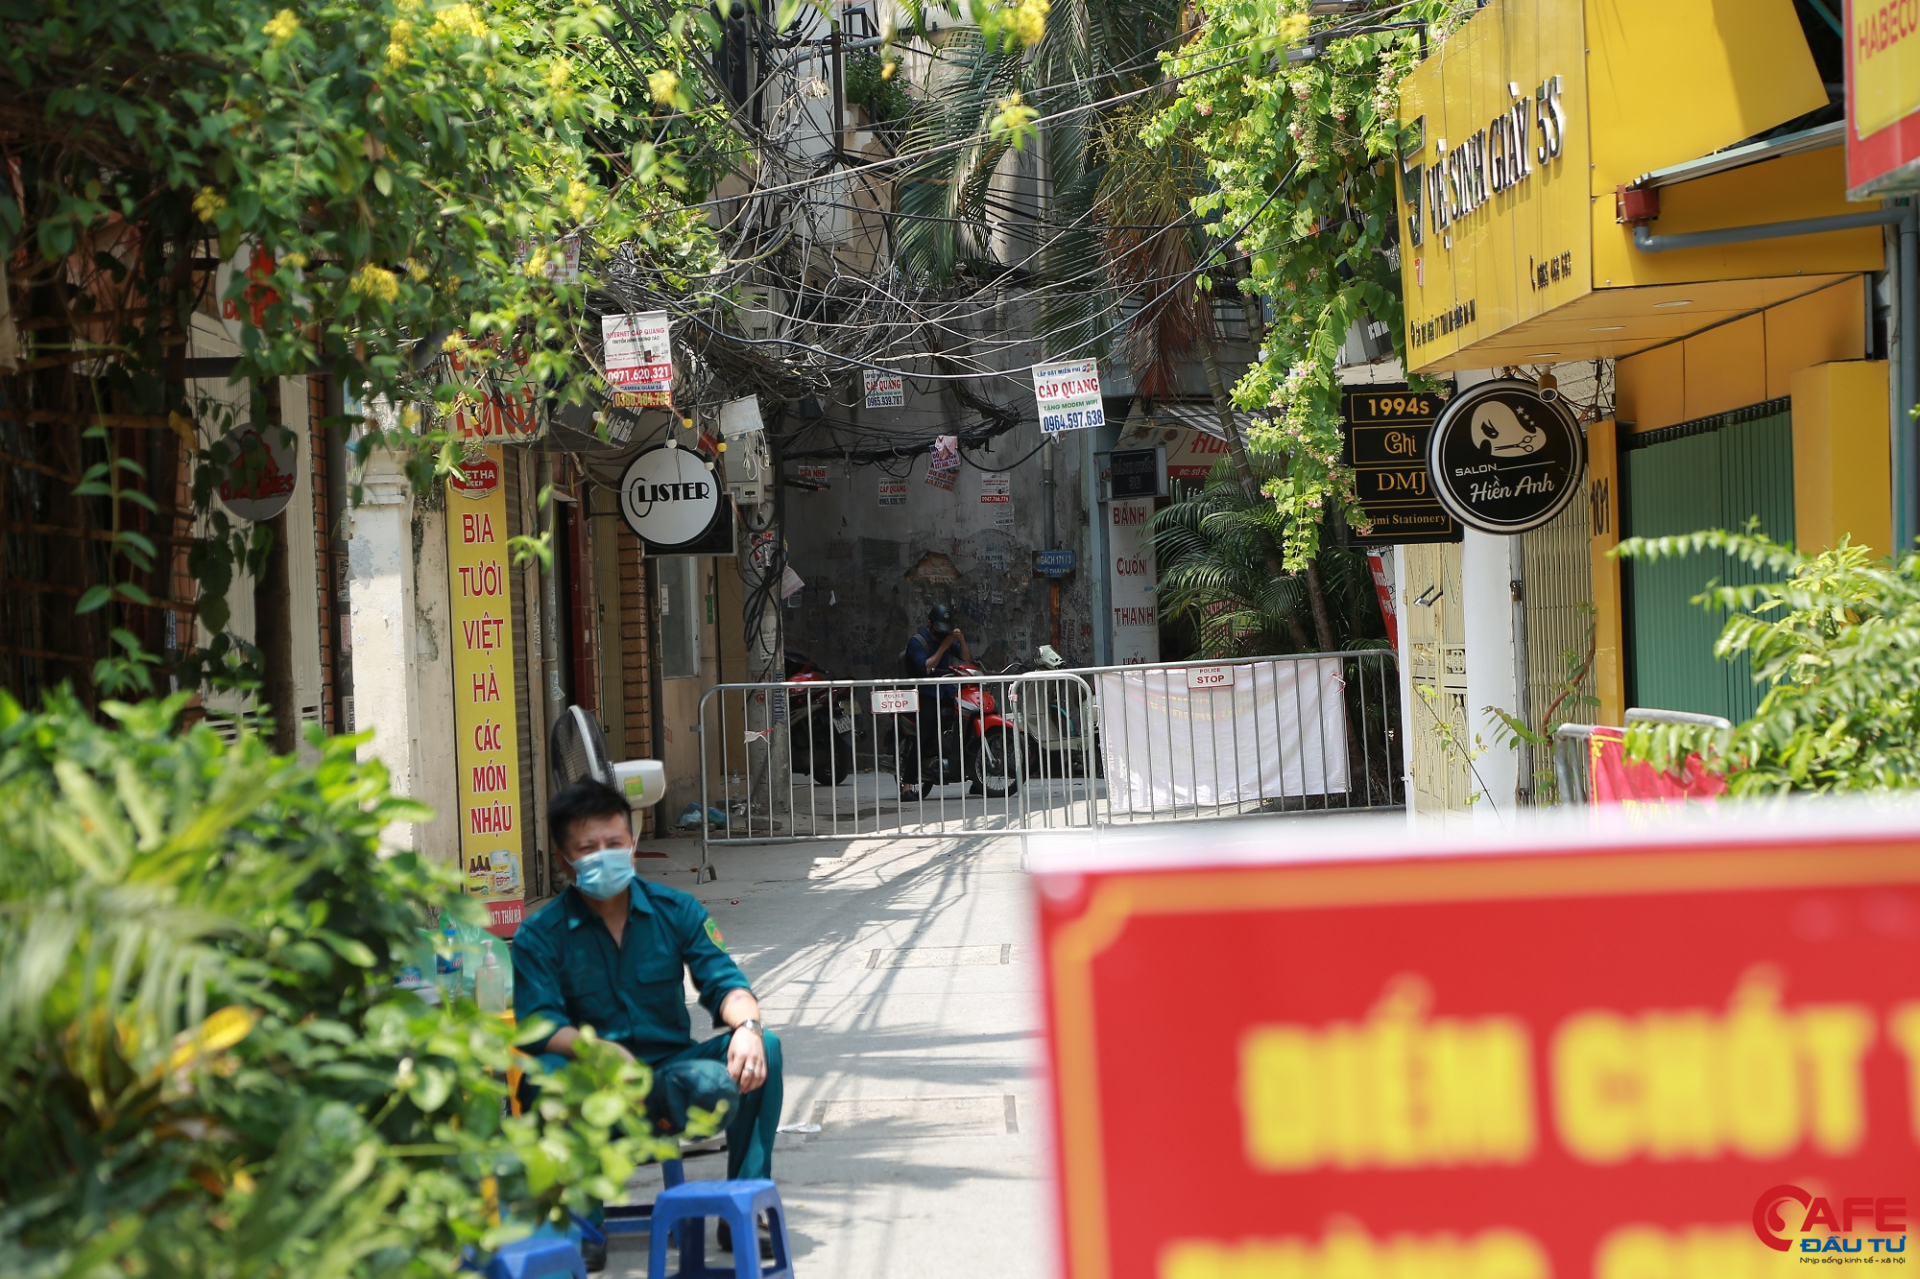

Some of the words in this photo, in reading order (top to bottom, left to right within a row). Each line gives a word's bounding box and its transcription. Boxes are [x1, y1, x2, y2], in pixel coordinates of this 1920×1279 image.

[1450, 127, 1490, 222] SINH
[608, 366, 669, 382] 0971.620.321
[1038, 380, 1059, 398] CÁP
[1061, 378, 1099, 399] QUANG
[1061, 401, 1085, 409] MODEM
[1368, 397, 1430, 416] 1994s
[1043, 409, 1103, 432] 0964.597.638
[1384, 431, 1417, 457] Ghi
[1455, 463, 1497, 477] SALON
[1376, 472, 1427, 495] DMJ
[1470, 475, 1513, 503] Hiền
[1513, 472, 1555, 497] Anh
[462, 513, 495, 543] BIA
[1392, 514, 1446, 525] Stationery
[458, 559, 503, 597] TƯƠI
[1114, 605, 1156, 626] THANH
[462, 611, 504, 656] VIỆT
[472, 664, 501, 703] HÀ
[1197, 675, 1224, 684] STOP
[881, 700, 908, 709] STOP
[474, 718, 502, 751] CÁC
[472, 759, 507, 793] MÓN
[470, 799, 512, 838] NHẬU
